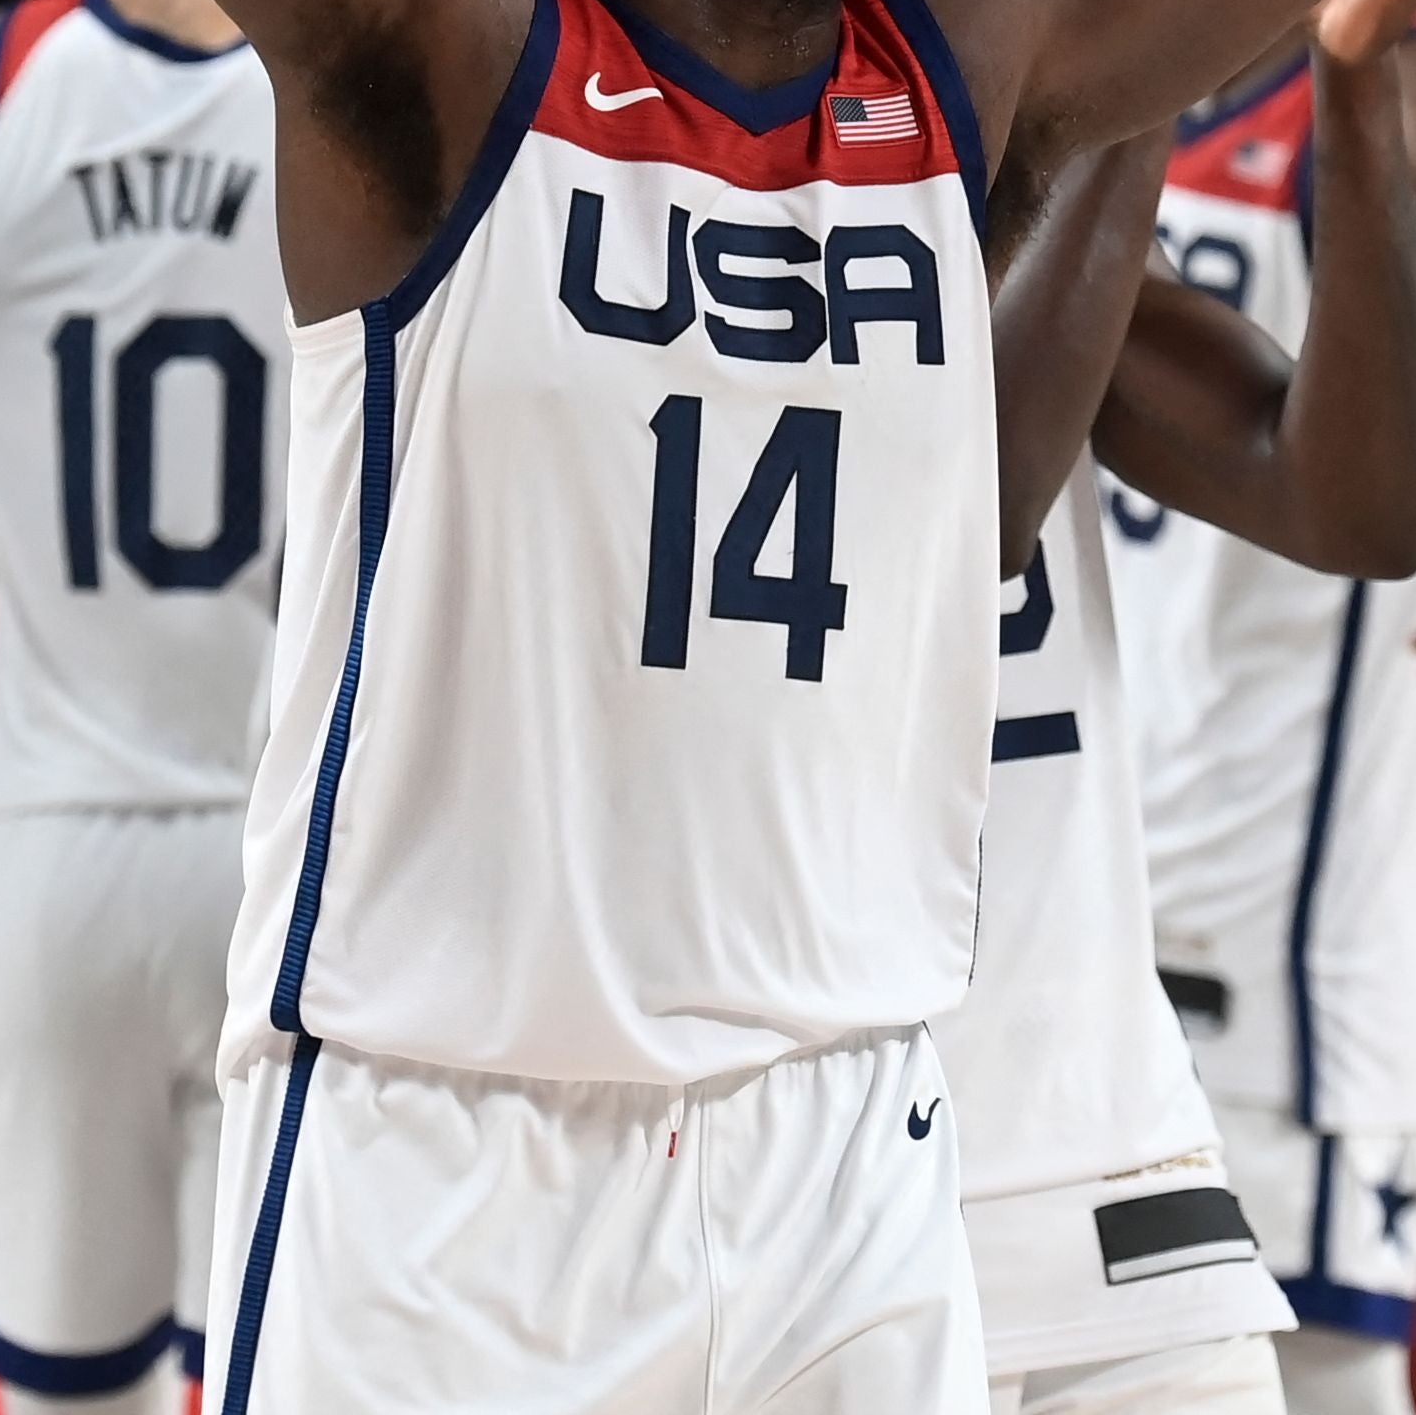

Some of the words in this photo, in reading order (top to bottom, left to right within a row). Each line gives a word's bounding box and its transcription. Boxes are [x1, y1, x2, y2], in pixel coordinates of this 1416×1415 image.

[559, 187, 945, 366] USA
[48, 310, 267, 594] 10
[640, 393, 848, 683] 14
